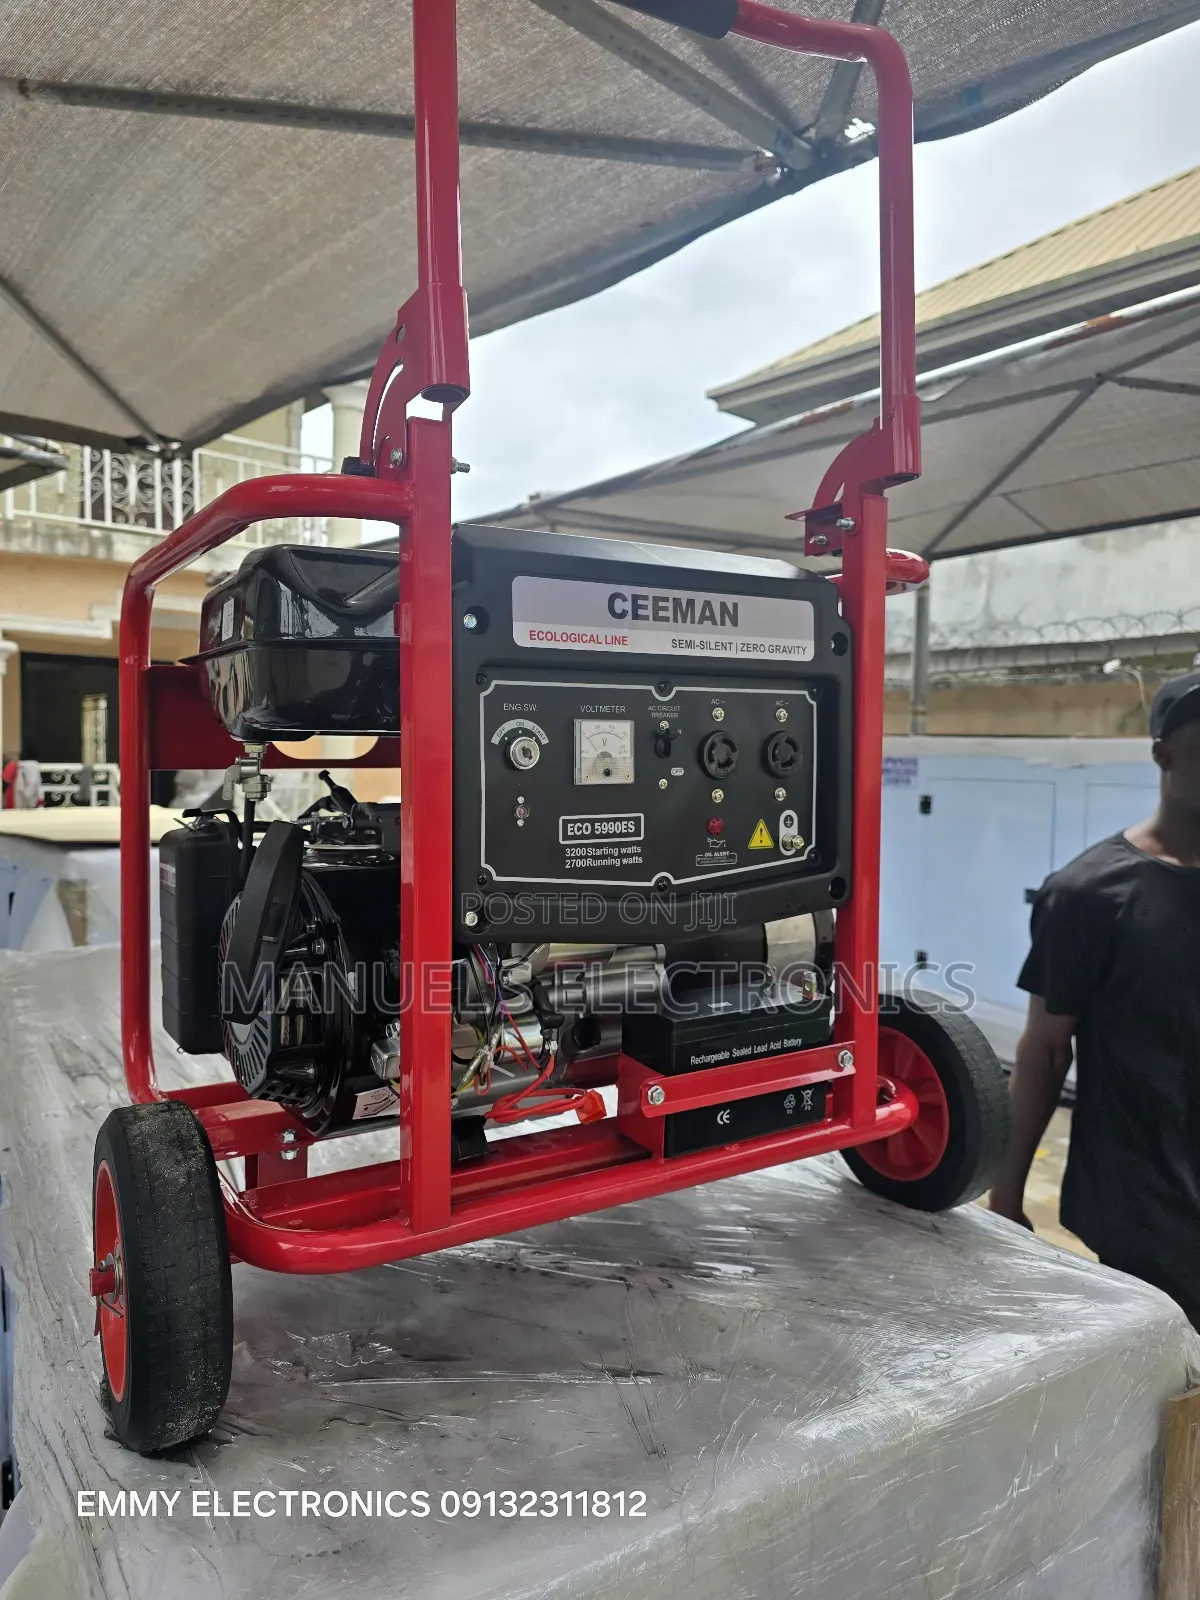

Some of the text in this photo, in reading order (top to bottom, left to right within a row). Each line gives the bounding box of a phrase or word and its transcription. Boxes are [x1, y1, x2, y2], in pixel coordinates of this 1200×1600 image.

[607, 592, 739, 627] CEEMAN
[529, 630, 629, 646] ECOLOGICAL LINE
[671, 638, 733, 652] SEMI-SILENT
[740, 643, 766, 653] ZERO
[768, 644, 807, 656] GRAVITY
[580, 704, 626, 714] VOLTMETER
[567, 820, 636, 836] ECO 5990ES
[620, 845, 642, 854] watts
[621, 856, 643, 865] watts
[690, 1037, 803, 1066] Rechargeable Sealed Lead Acid Battery
